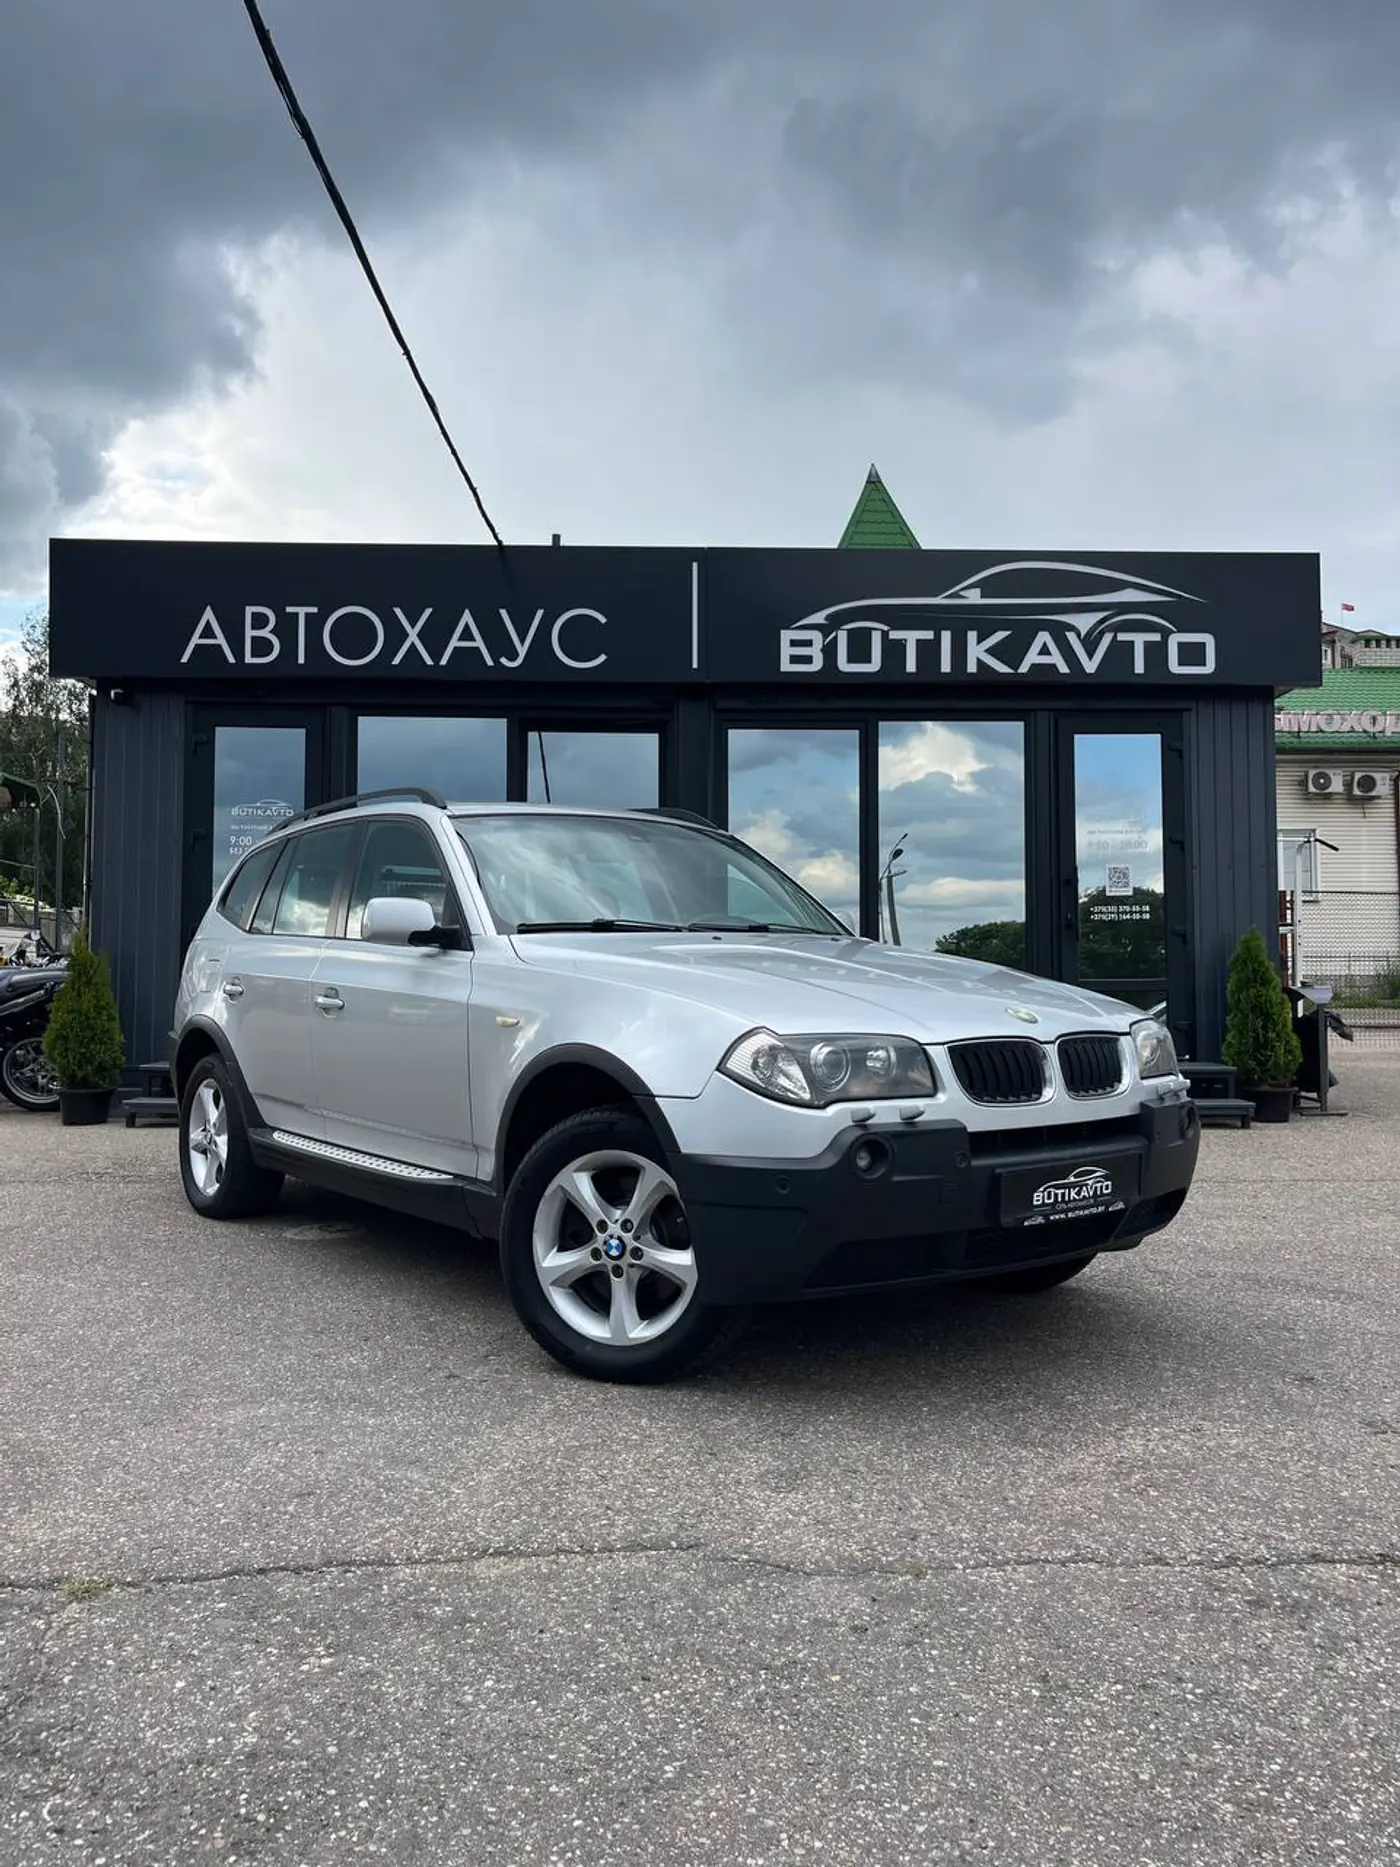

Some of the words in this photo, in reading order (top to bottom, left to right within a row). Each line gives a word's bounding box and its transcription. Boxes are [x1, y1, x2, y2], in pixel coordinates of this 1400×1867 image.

[180, 605, 608, 669] АВТОХАУС
[780, 628, 1216, 675] BUTIKAVTO
[231, 807, 294, 817] BUTIKAVTO
[229, 835, 253, 846] 9:00
[1033, 1180, 1112, 1205] BUTIKAVTO
